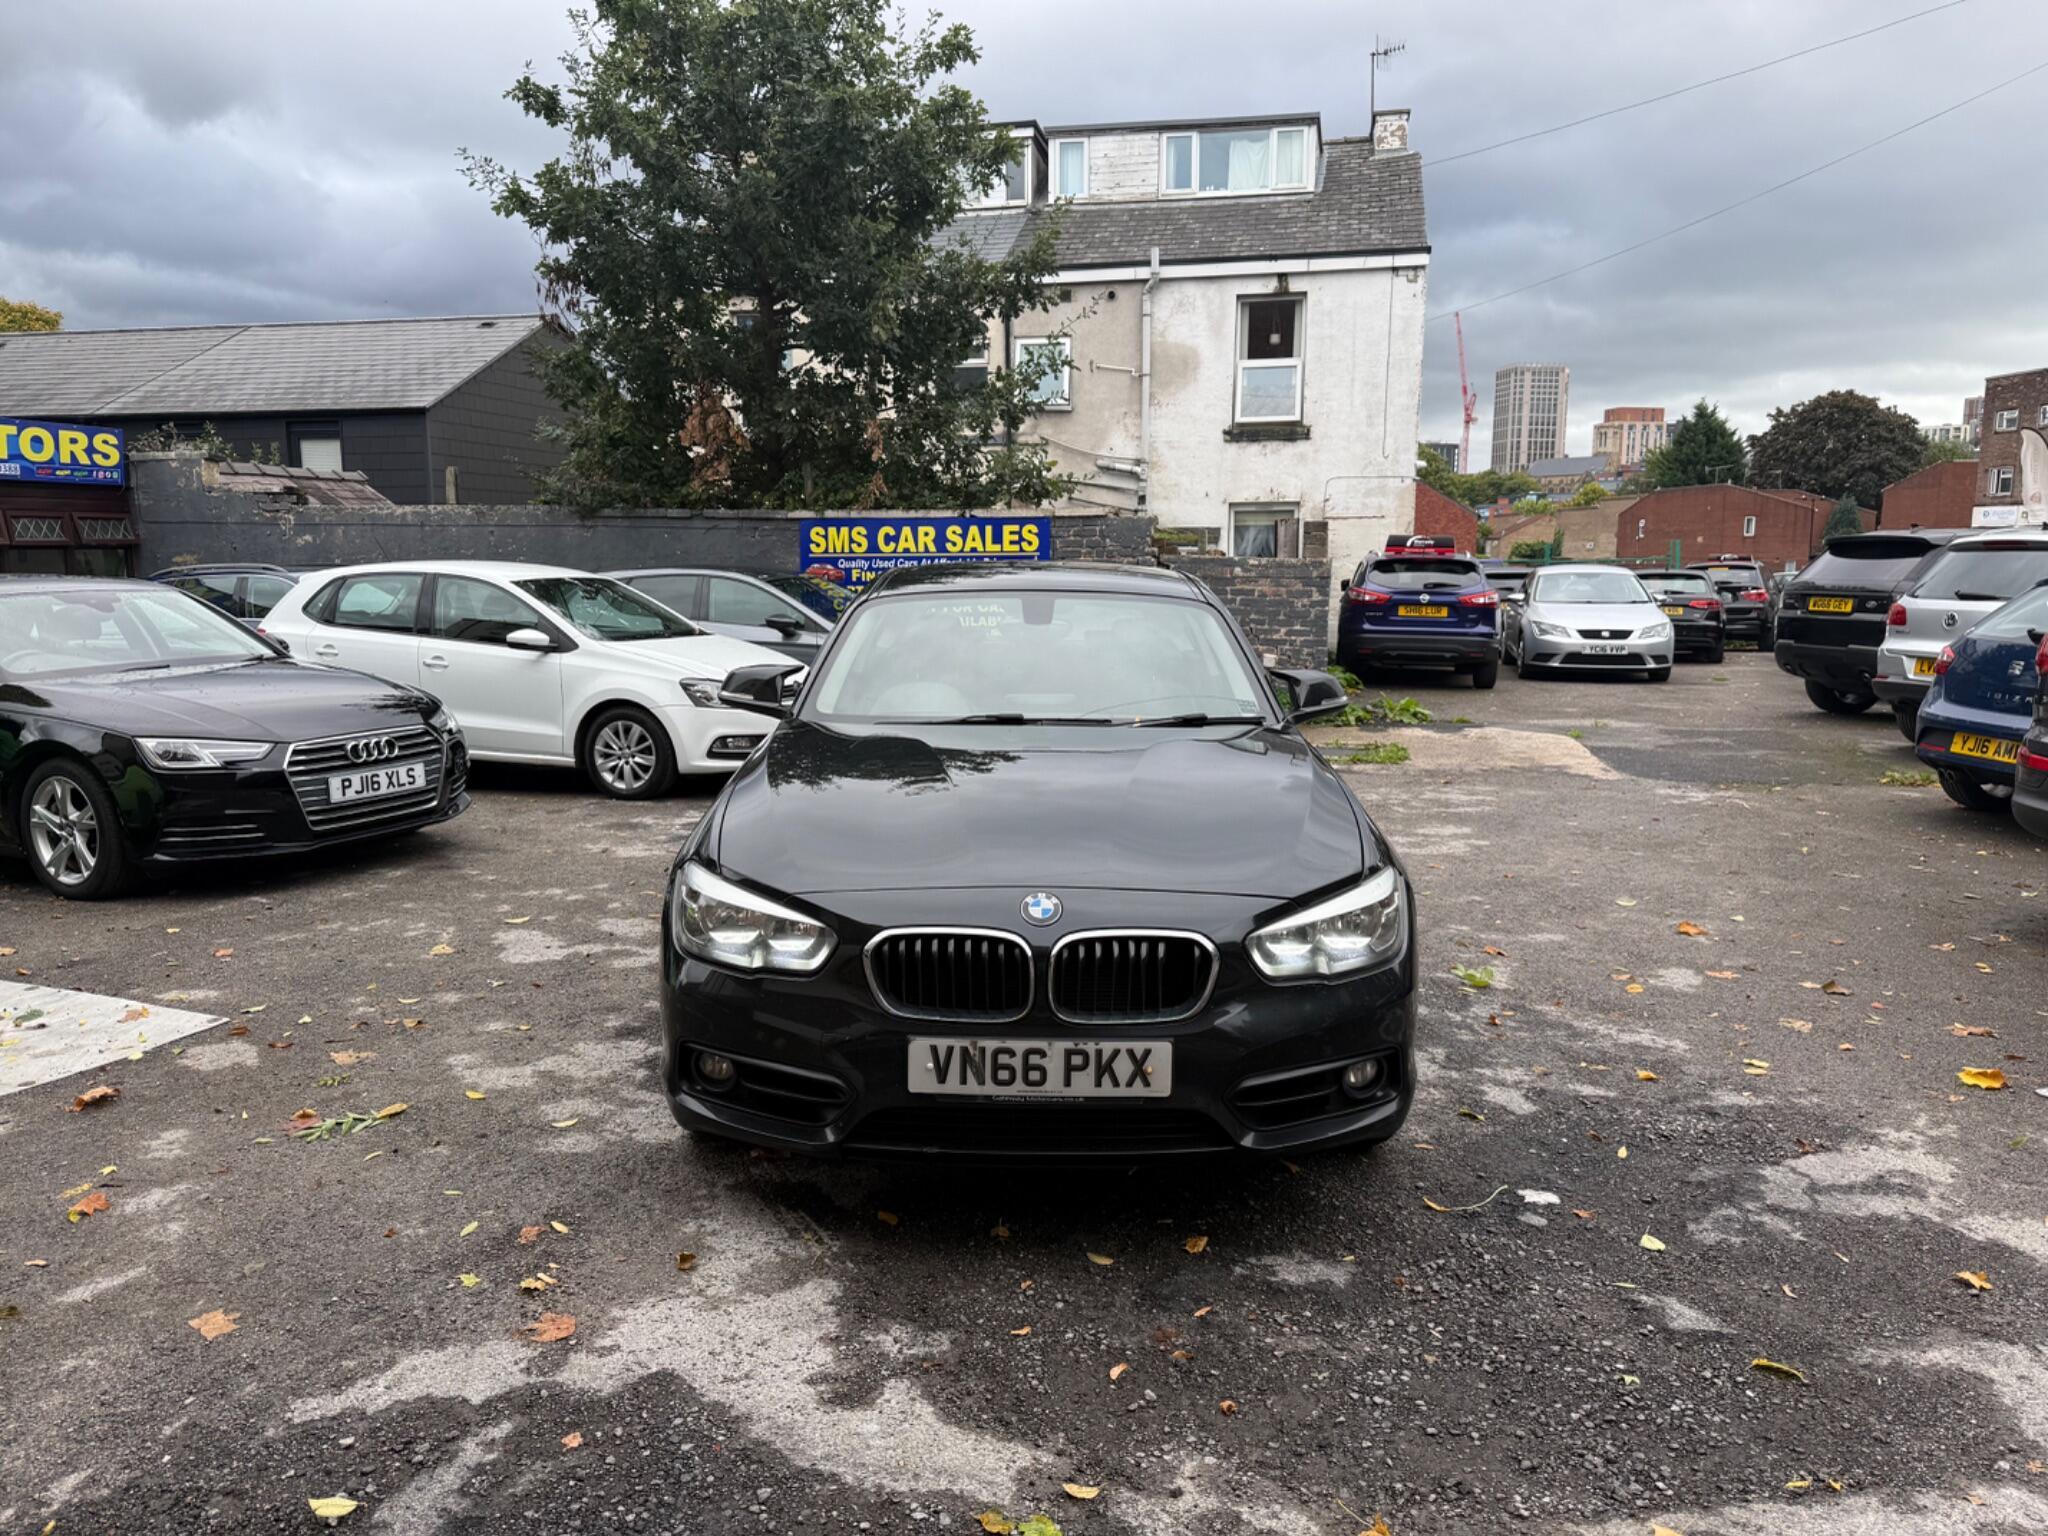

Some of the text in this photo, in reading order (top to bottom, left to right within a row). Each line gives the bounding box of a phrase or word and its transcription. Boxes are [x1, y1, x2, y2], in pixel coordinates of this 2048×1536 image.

[0, 425, 120, 467] TORS
[809, 524, 1039, 553] SMS CAR SALES
[838, 559, 870, 570] Quality
[872, 559, 894, 569] Used
[897, 559, 918, 568] Cars
[1960, 735, 1991, 755] YJ16
[341, 768, 417, 796] PJ16 XLS
[929, 1044, 1152, 1089] VN66 PKX
